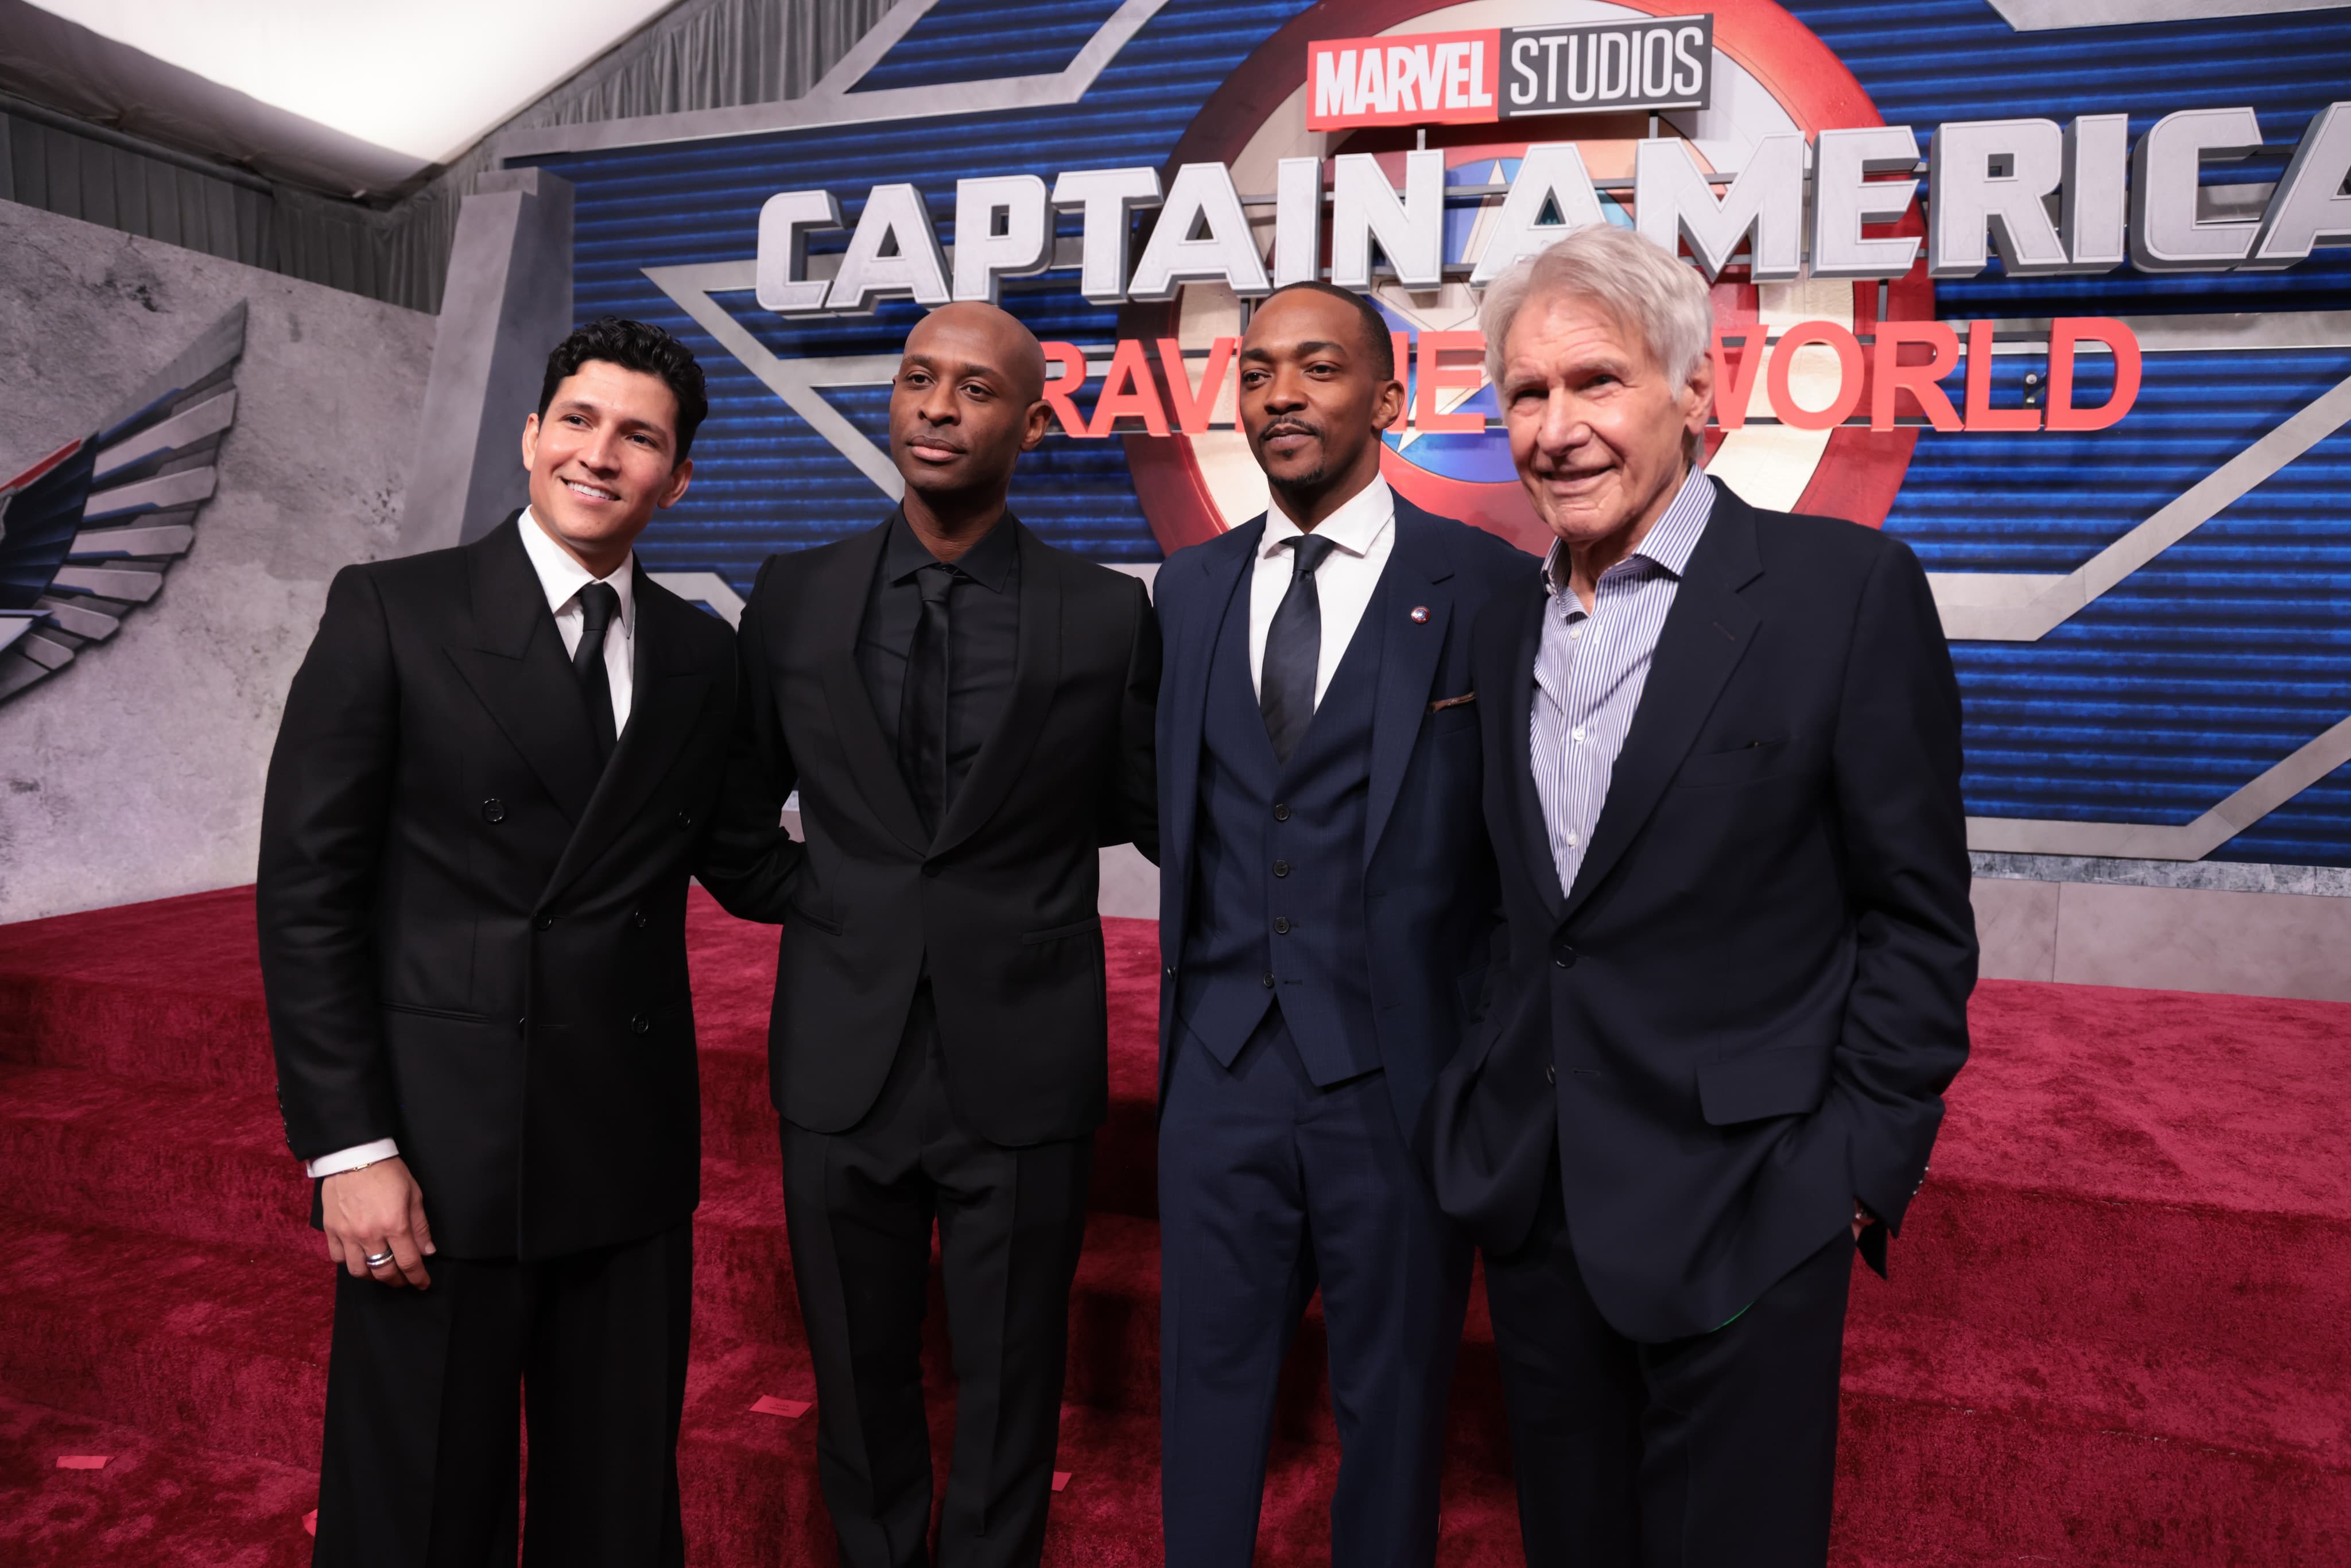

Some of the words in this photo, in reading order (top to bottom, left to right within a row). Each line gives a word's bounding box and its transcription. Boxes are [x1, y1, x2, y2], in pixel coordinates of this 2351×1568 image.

[1314, 40, 1492, 117] MARVEL
[1510, 26, 1704, 106] STUDIOS
[755, 149, 1446, 320] CAPTAIN
[1040, 336, 1247, 438] RAV
